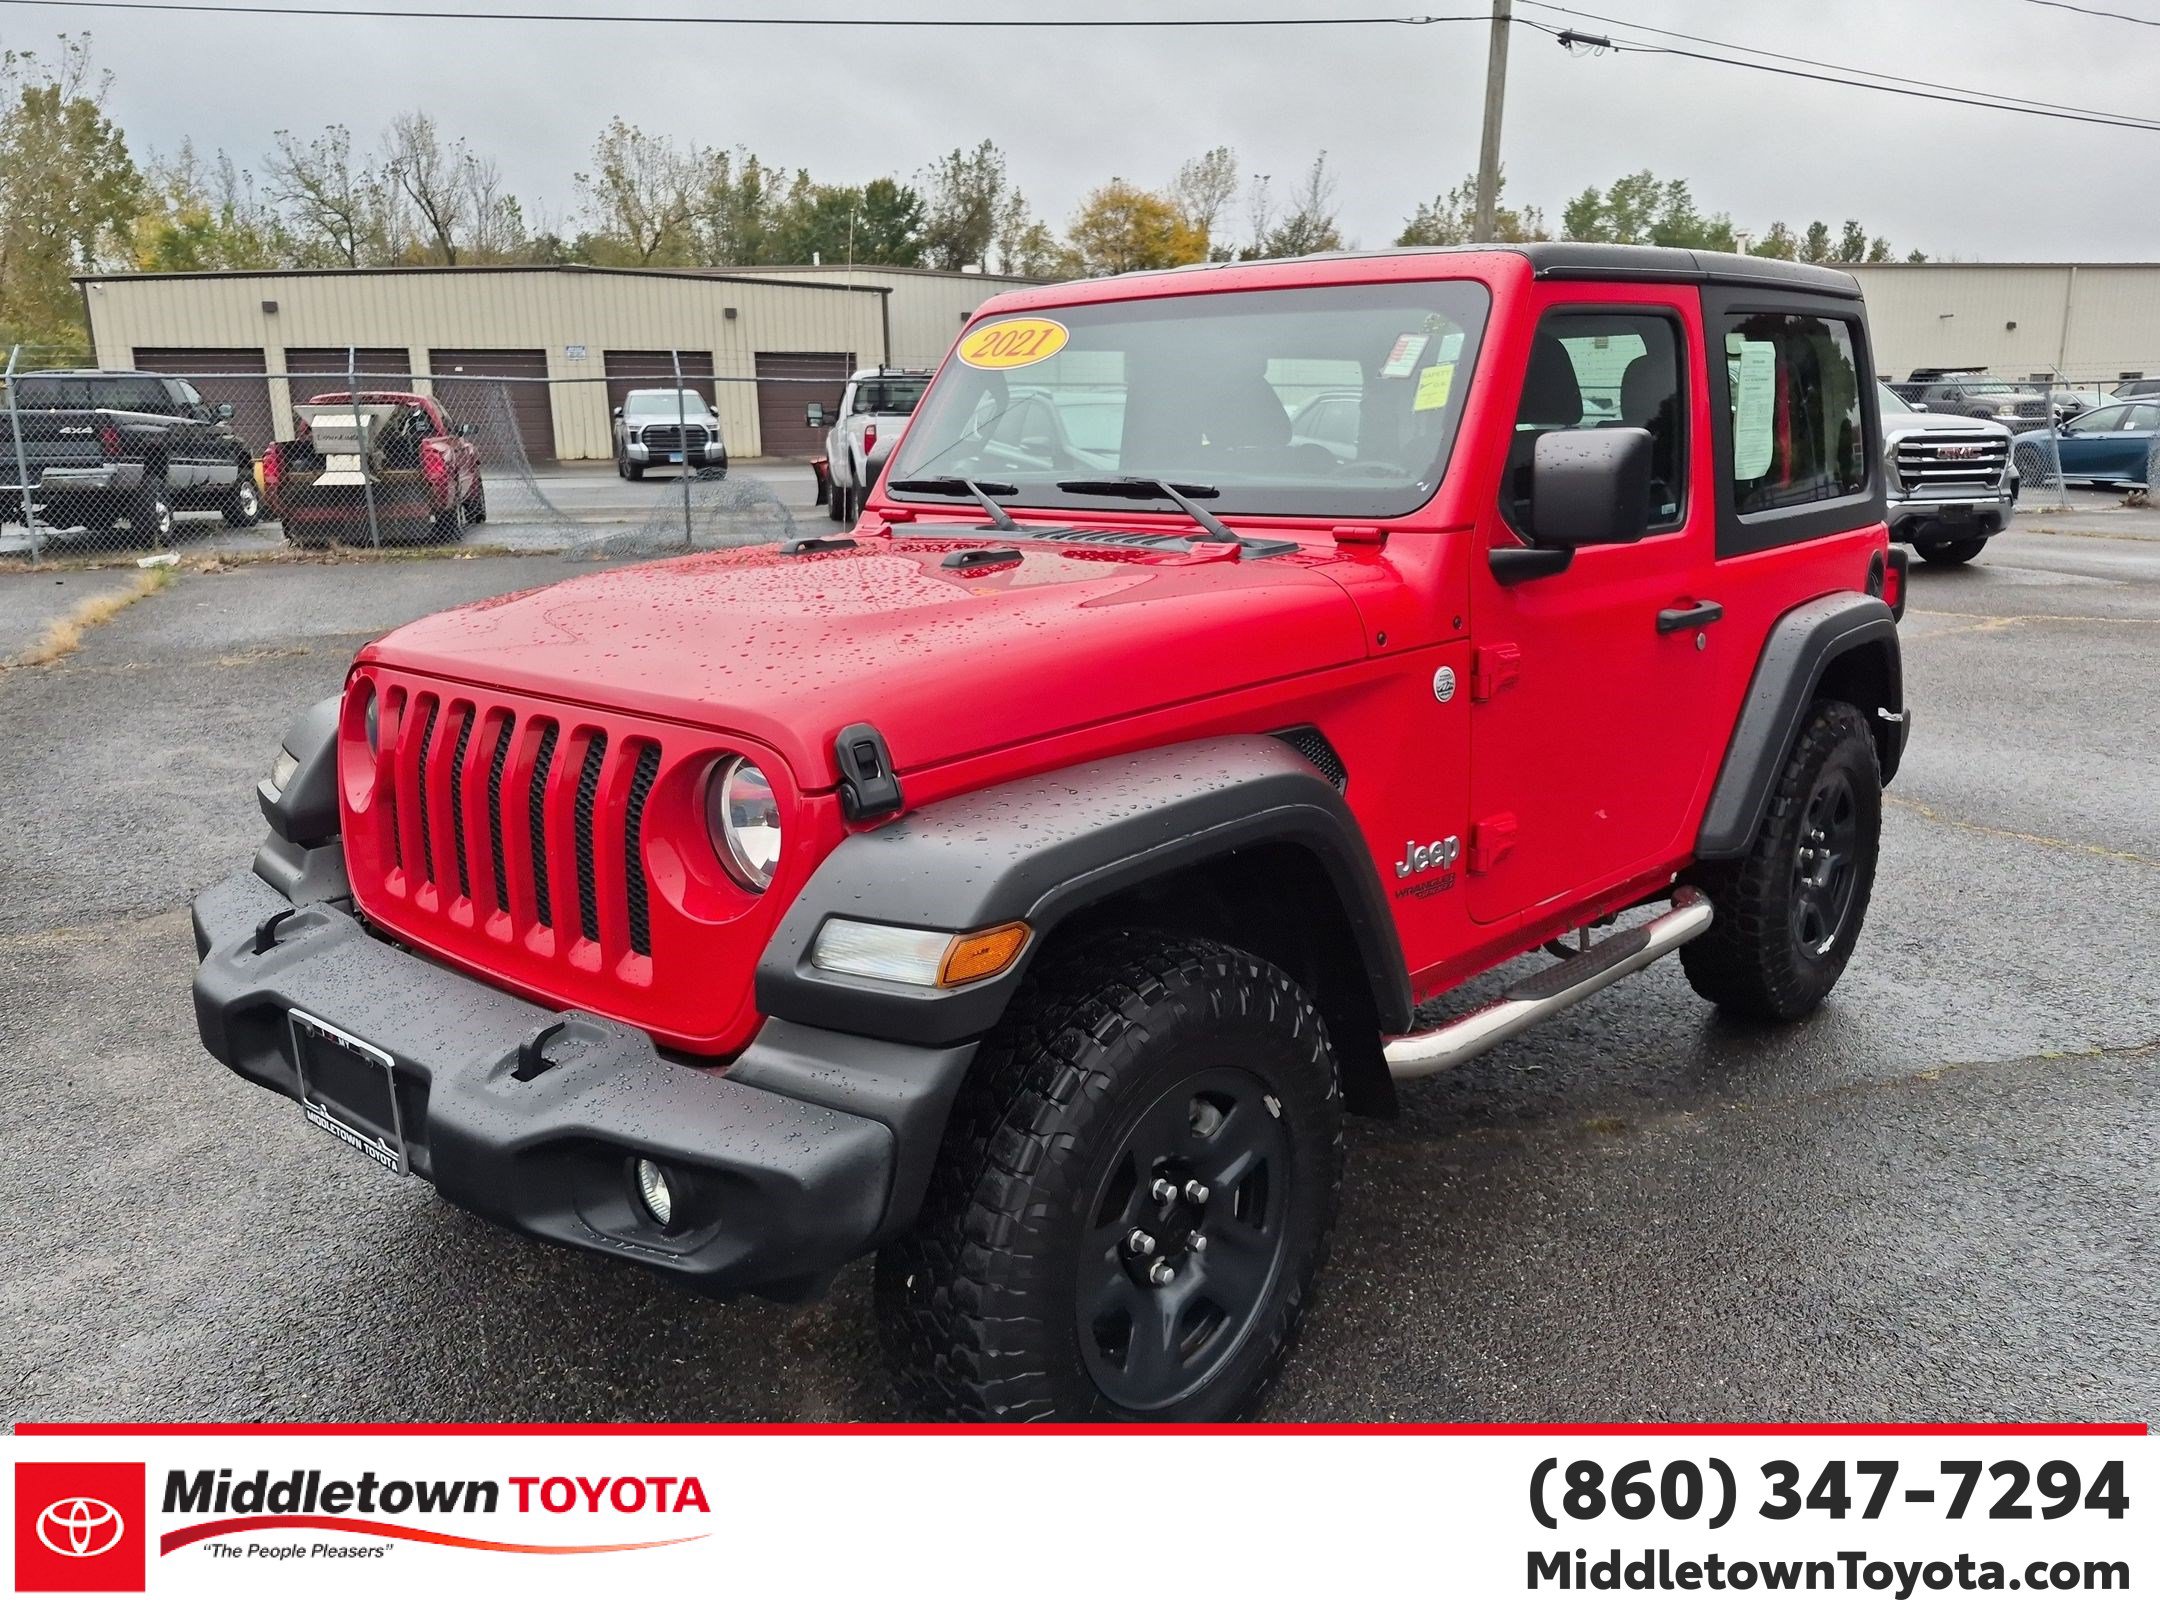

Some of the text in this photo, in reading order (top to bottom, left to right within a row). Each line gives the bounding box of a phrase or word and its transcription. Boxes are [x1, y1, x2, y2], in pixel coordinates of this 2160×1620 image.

[970, 328, 1055, 358] 2021
[1937, 447, 1983, 459] GMC
[1395, 834, 1461, 879] Jeep
[307, 1110, 398, 1172] MIDDLETOWN TOYOTA
